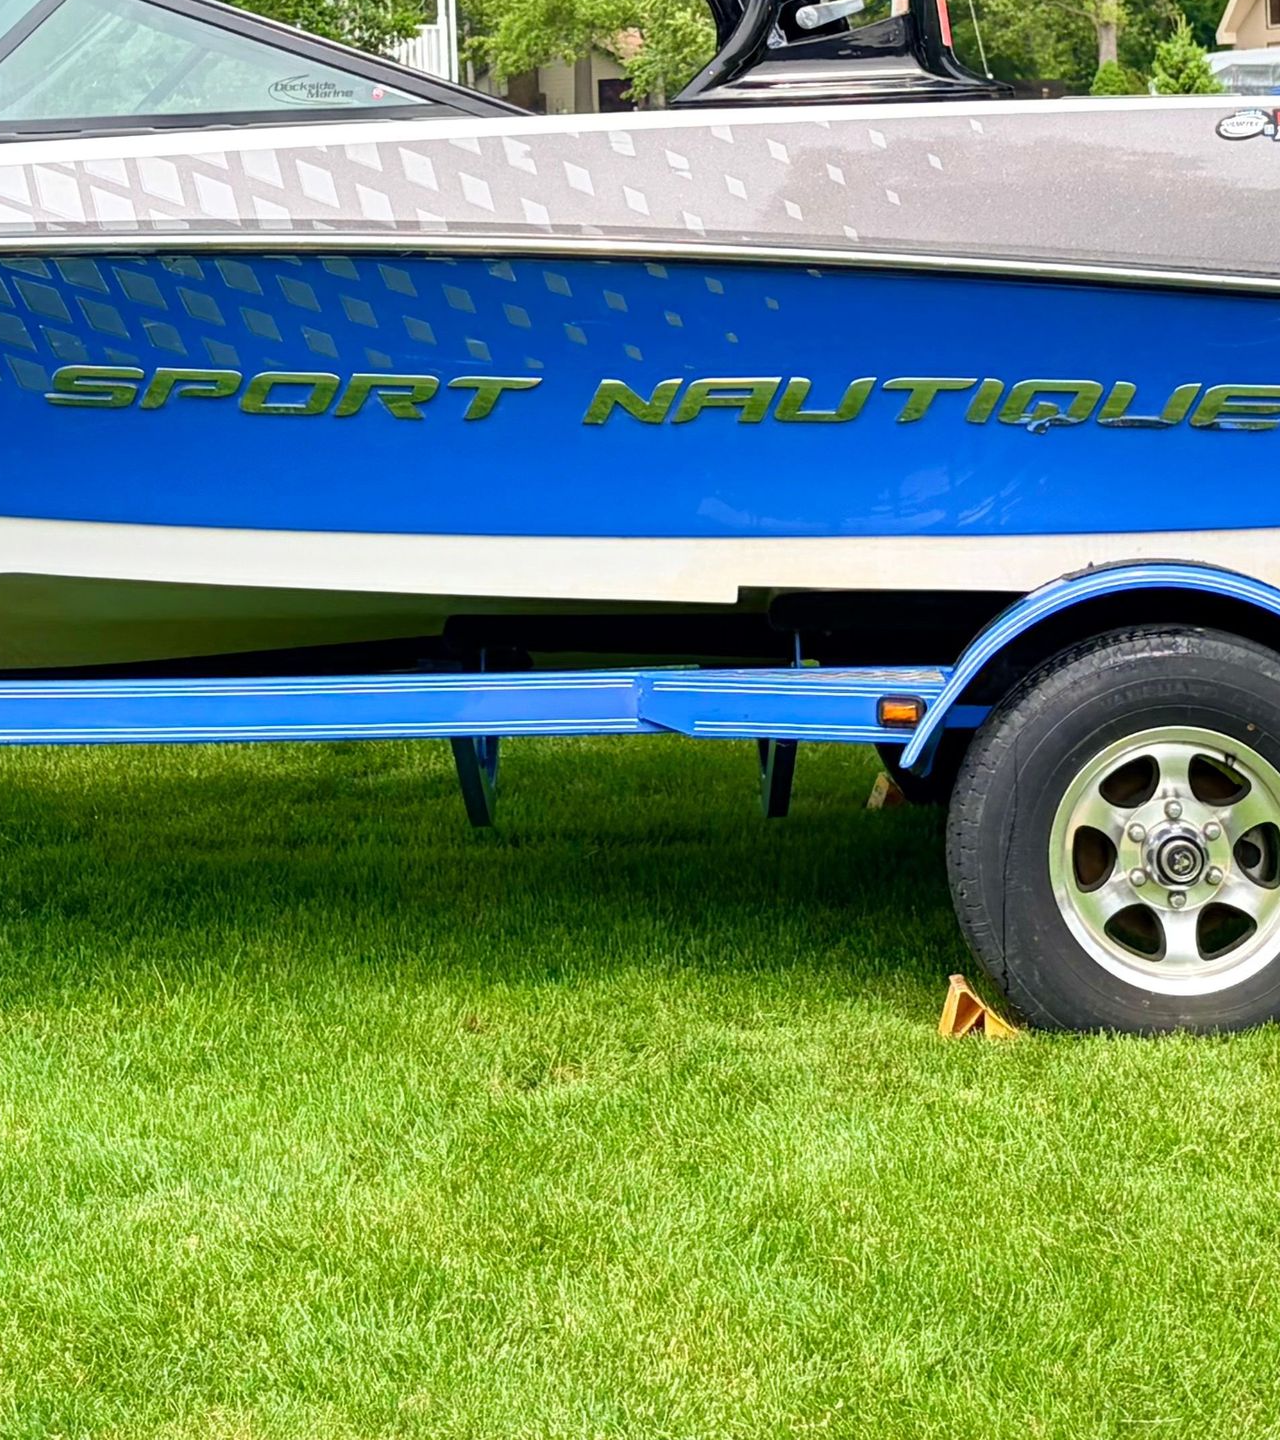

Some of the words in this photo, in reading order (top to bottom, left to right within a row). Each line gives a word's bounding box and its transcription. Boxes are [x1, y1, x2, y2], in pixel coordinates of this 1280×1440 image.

[274, 81, 336, 92] Dockside
[306, 88, 354, 99] Marine
[44, 364, 543, 421] SPORT
